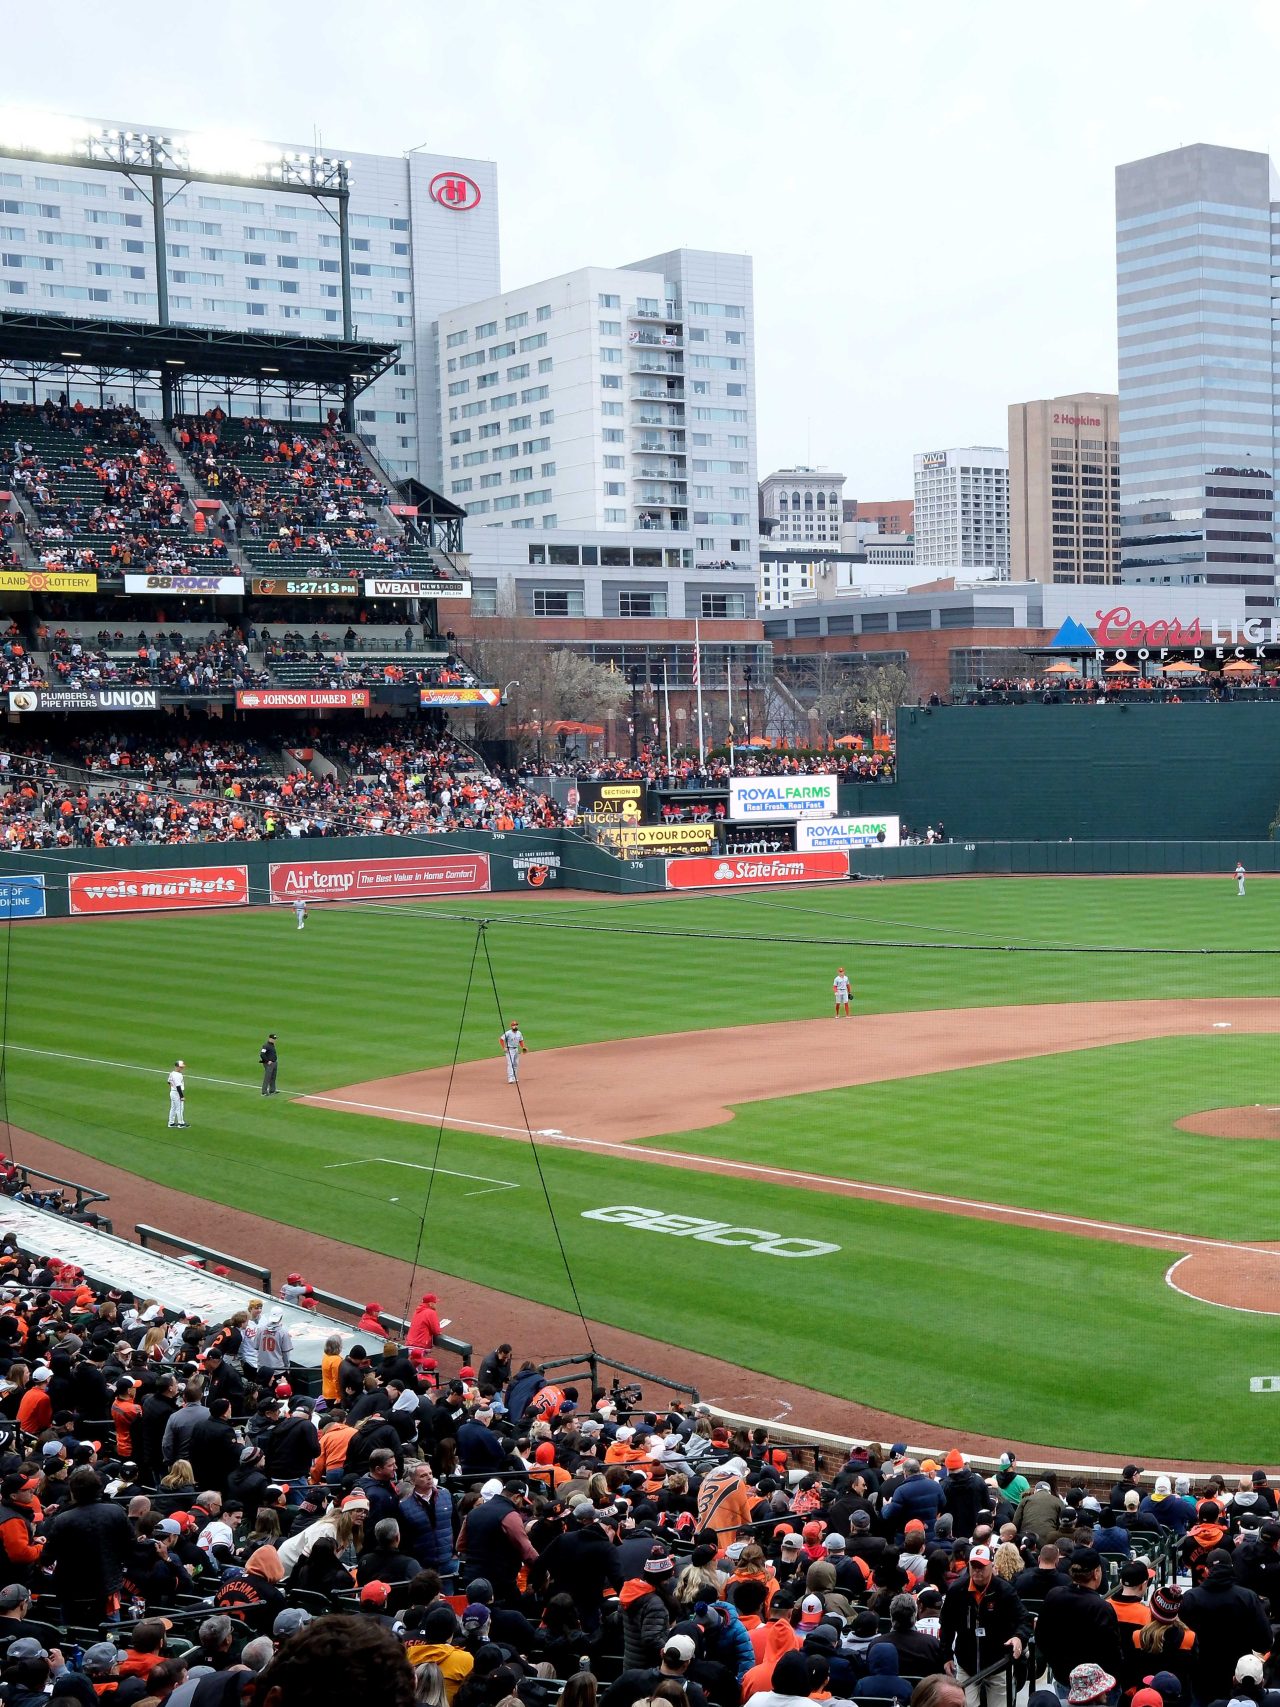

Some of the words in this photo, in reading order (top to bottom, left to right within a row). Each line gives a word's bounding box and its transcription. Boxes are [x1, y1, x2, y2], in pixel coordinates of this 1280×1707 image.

[1054, 414, 1060, 423] 2
[1062, 414, 1100, 427] Hopkins
[50, 576, 89, 586] LOTTERY
[147, 577, 223, 589] 98ROCK
[287, 582, 339, 593] 5:27:13
[376, 582, 418, 594] WBAL
[1096, 606, 1202, 646] Coors
[1096, 648, 1168, 660] ROOF
[1194, 646, 1266, 659] DECK
[100, 691, 156, 706] UNION
[263, 695, 307, 704] JOHNSON
[310, 694, 347, 704] LUMBER
[738, 787, 830, 800] ROYALFARMS
[594, 801, 620, 812] PAT
[649, 831, 678, 840] YOUR
[681, 830, 711, 839] DOOR
[807, 824, 886, 837] ROYALFARMS
[513, 856, 560, 868] CHAMPIONS
[285, 870, 353, 890] Airtemp
[361, 876, 374, 884] The
[376, 874, 392, 883] Best
[394, 873, 413, 882] Value
[423, 872, 444, 880] Home
[445, 870, 473, 879] Comfort
[84, 881, 138, 899] weis
[141, 877, 236, 896] markets
[580, 1206, 842, 1258] GEICO
[263, 1337, 276, 1352] 10
